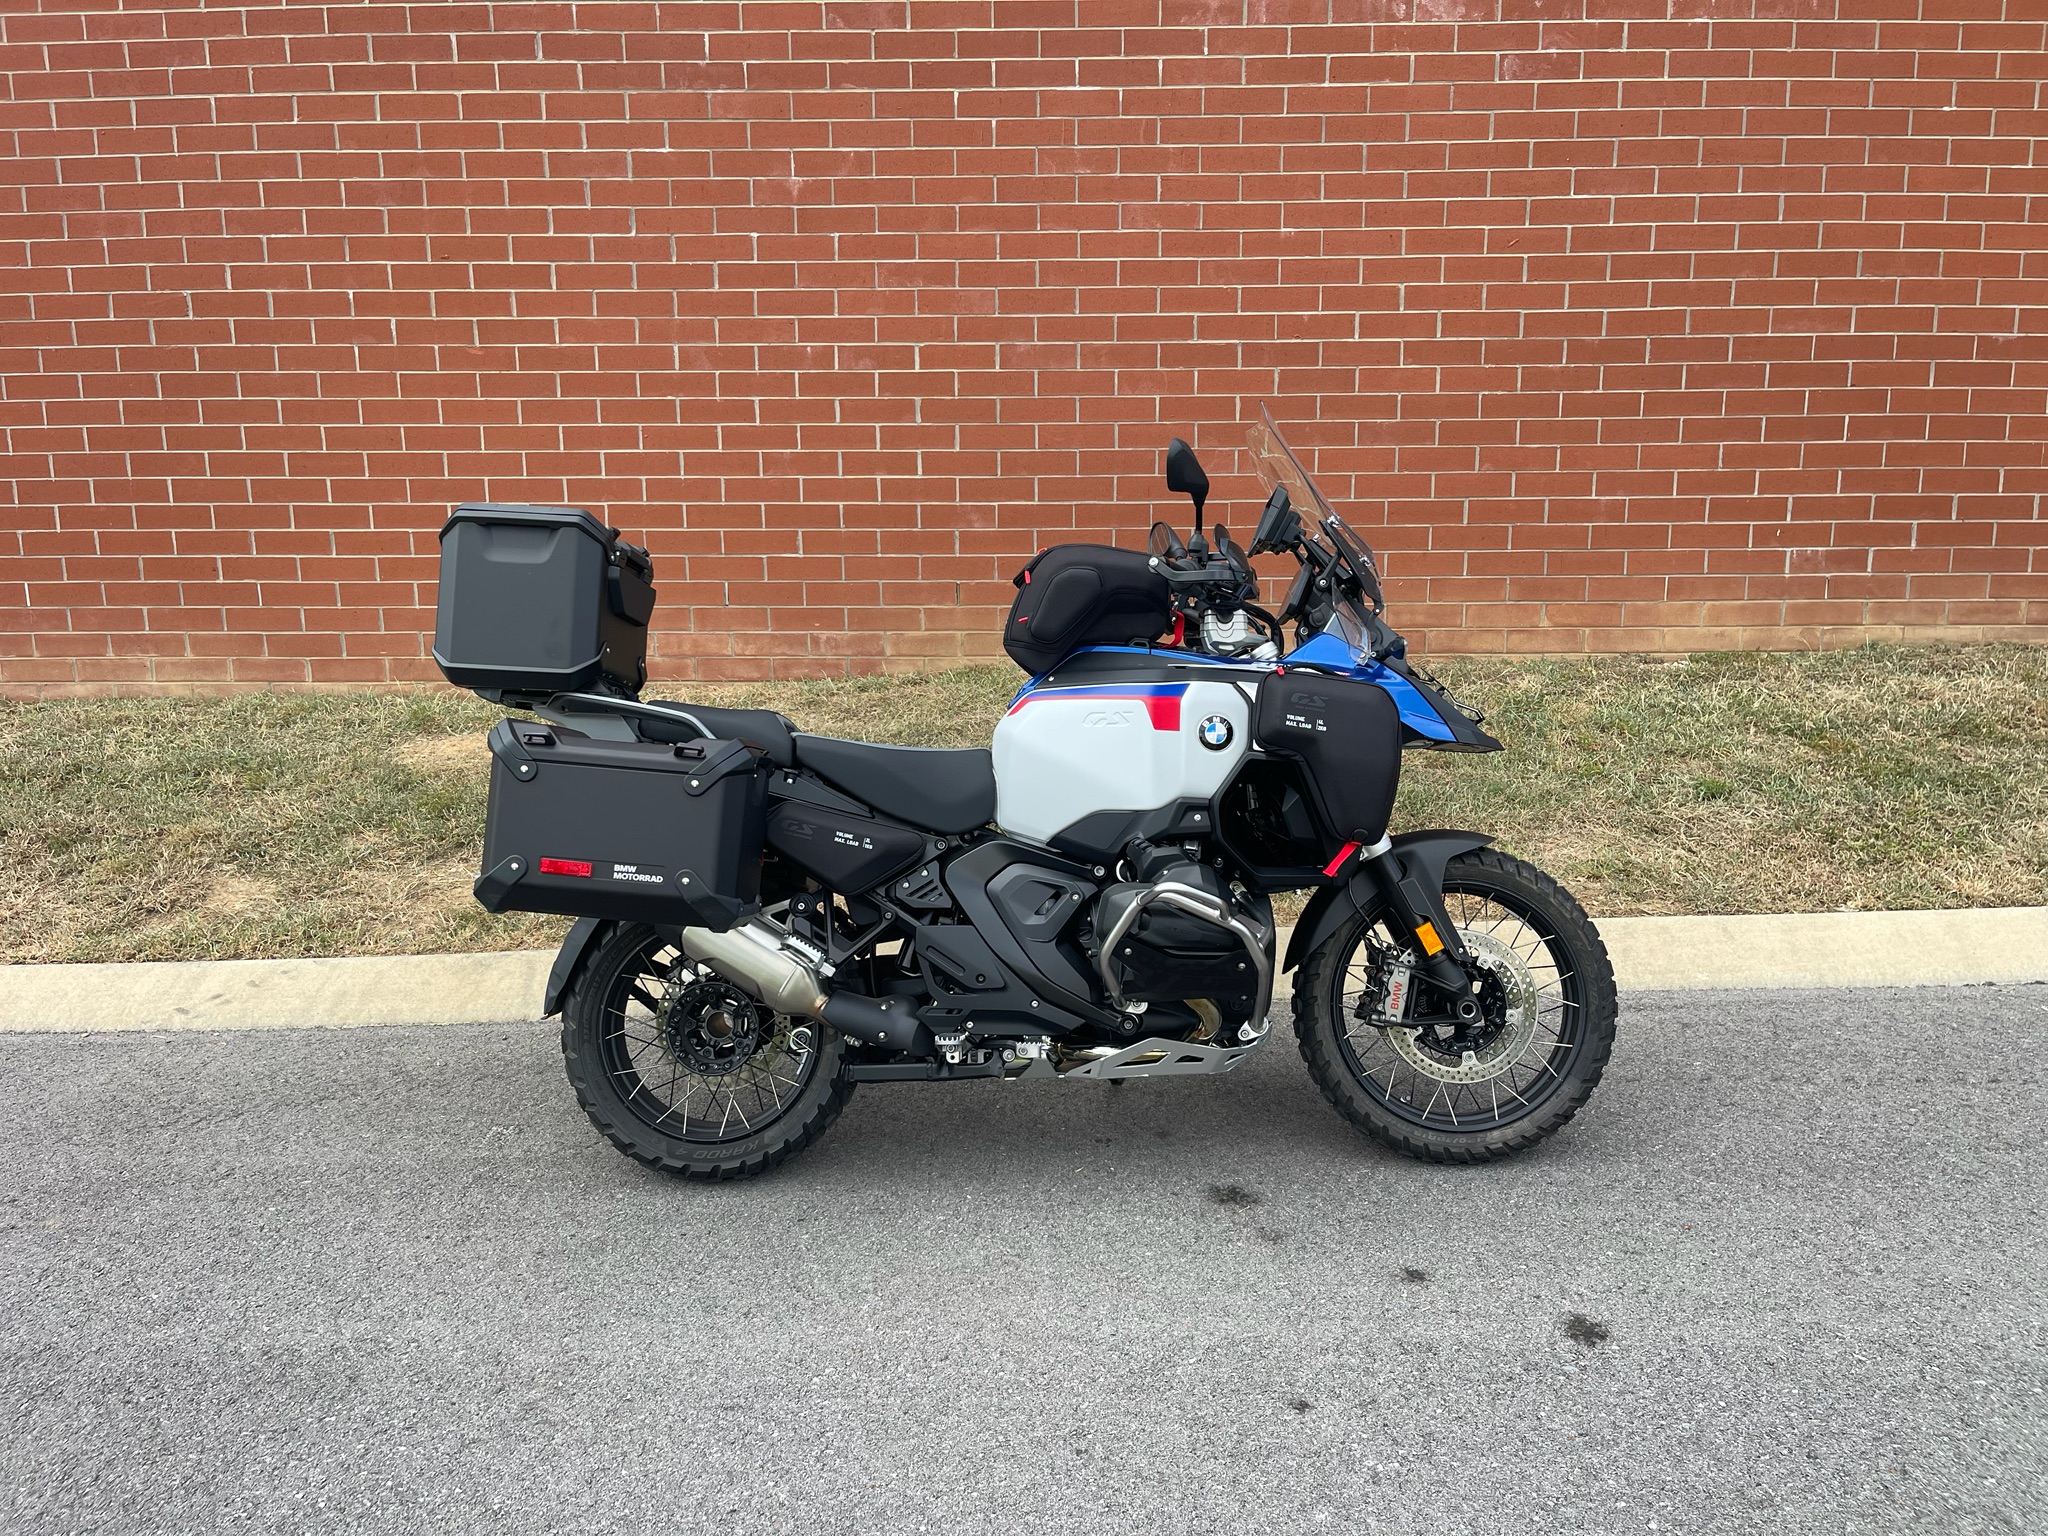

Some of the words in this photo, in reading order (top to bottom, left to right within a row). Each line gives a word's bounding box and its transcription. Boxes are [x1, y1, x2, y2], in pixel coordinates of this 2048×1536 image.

[1286, 714, 1306, 722] VOLUME
[836, 831, 854, 839] VOLUME
[846, 839, 860, 847] LOAD
[614, 864, 637, 873] BMW
[613, 872, 664, 883] MOTORRAD
[1390, 981, 1403, 1010] BMW
[693, 1140, 760, 1159] KAROO
